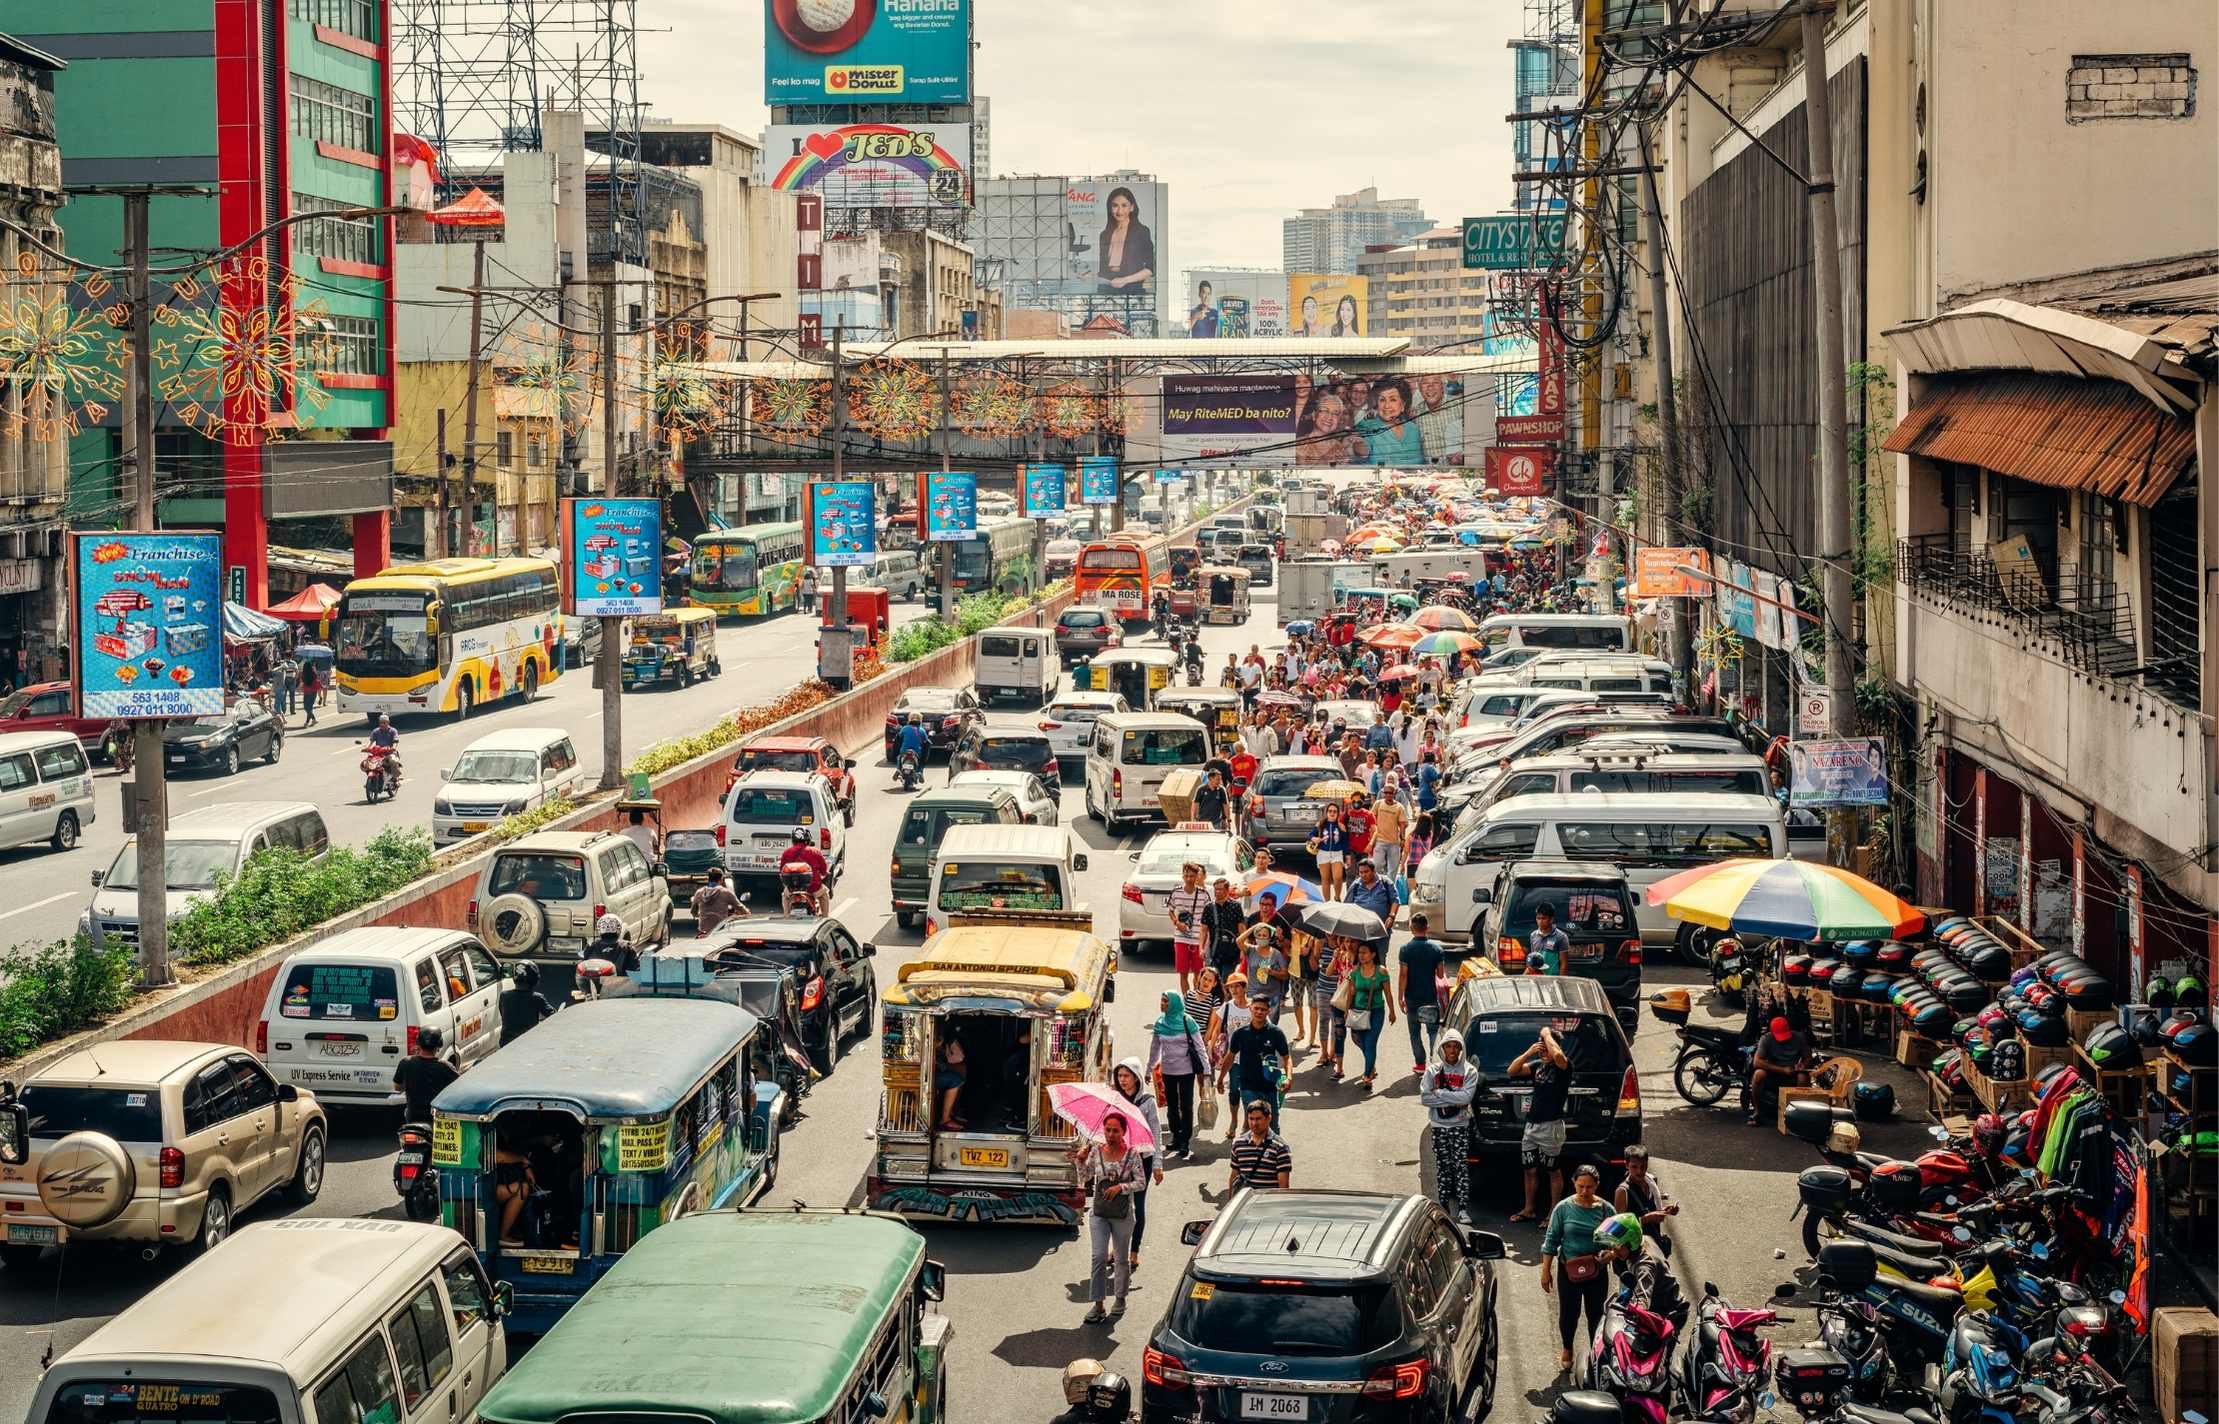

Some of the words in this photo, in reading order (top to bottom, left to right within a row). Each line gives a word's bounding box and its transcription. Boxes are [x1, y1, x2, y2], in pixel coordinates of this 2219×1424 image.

[772, 77, 790, 86] Feel
[791, 77, 801, 86] ko
[803, 78, 820, 88] mag
[849, 79, 898, 89] Donut
[792, 137, 803, 157] I
[845, 132, 936, 163] JED'S
[935, 177, 960, 193] 24
[1468, 253, 1497, 263] HOTEL
[1259, 320, 1278, 328] 100%
[1254, 328, 1283, 337] ACRYLIC
[1174, 384, 1200, 395] Huwag
[1168, 408, 1192, 422] May
[1194, 407, 1243, 419] RiteMED
[1246, 407, 1259, 419] ba
[1262, 406, 1291, 419] nito?
[1497, 421, 1563, 436] PAWNSHOP
[132, 546, 204, 561] Franchise
[1102, 590, 1116, 599] MA
[1118, 591, 1142, 600] ROSE
[133, 693, 153, 704] 563
[118, 705, 144, 716] 0927
[146, 704, 166, 715] 011
[167, 703, 193, 715] 8000
[1812, 754, 1863, 768] NAZARENO
[933, 962, 953, 971] SAN
[953, 963, 995, 972] ANTONIO
[997, 964, 1039, 975] SPURS
[291, 1069, 301, 1080] UV
[303, 1069, 327, 1083] Express
[328, 1070, 351, 1081] Service
[622, 1149, 636, 1158] TEXT
[966, 1150, 982, 1161] TWZ
[988, 1152, 1004, 1162] 122
[960, 1190, 991, 1198] KING
[1265, 1361, 1283, 1371] Ford
[121, 1384, 135, 1393] 24
[137, 1384, 180, 1402] BENTE
[179, 1394, 190, 1404] ON
[137, 1401, 178, 1411] QUATRO
[1270, 1398, 1301, 1413] 2063
